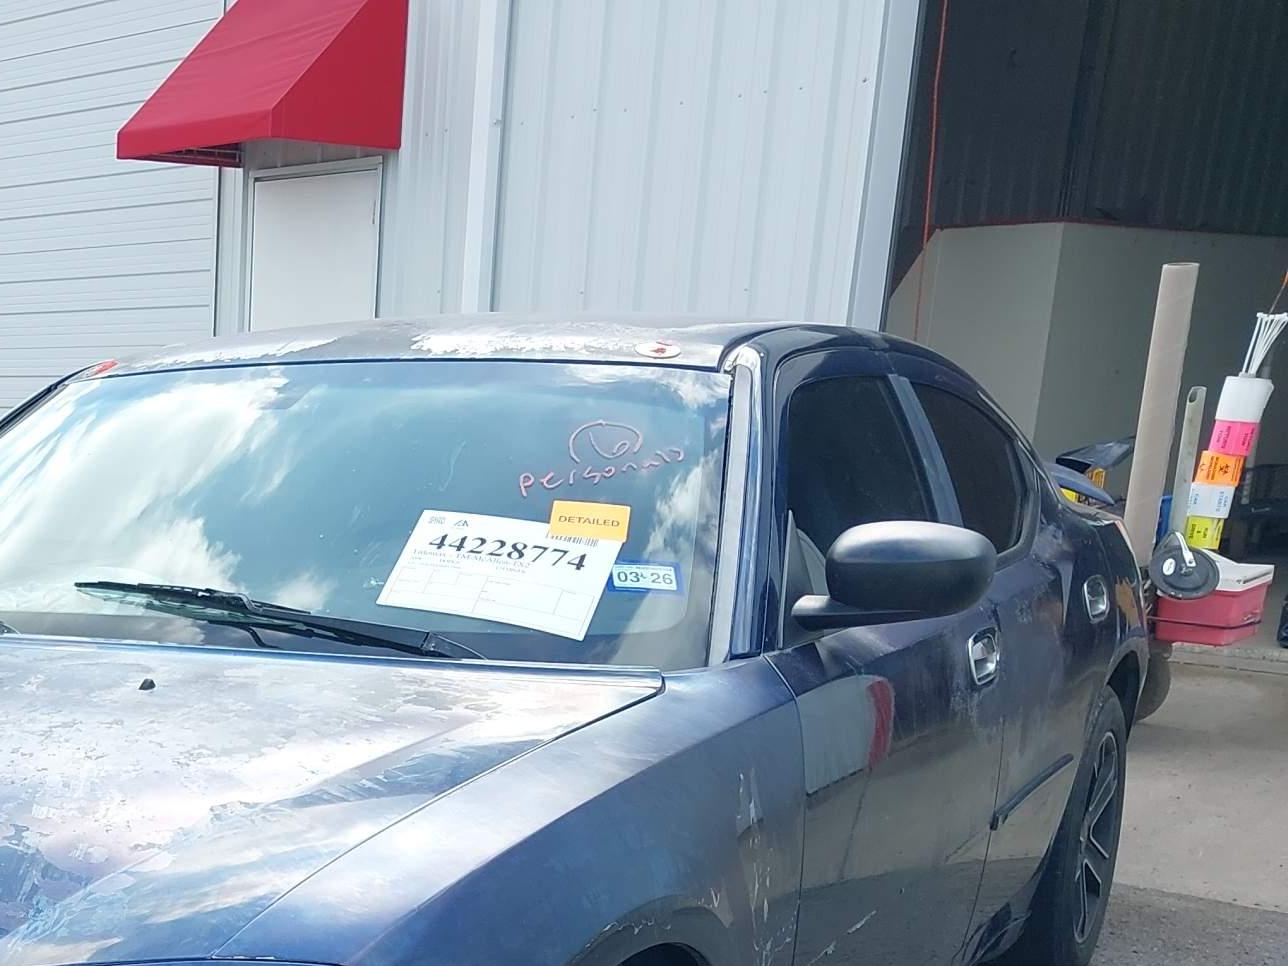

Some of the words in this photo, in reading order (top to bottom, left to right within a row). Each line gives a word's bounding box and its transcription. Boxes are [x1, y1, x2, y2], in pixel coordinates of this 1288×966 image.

[557, 515, 621, 528] DETAILED
[428, 533, 588, 571] 44228774
[617, 570, 641, 583] 03
[650, 572, 674, 585] 26
